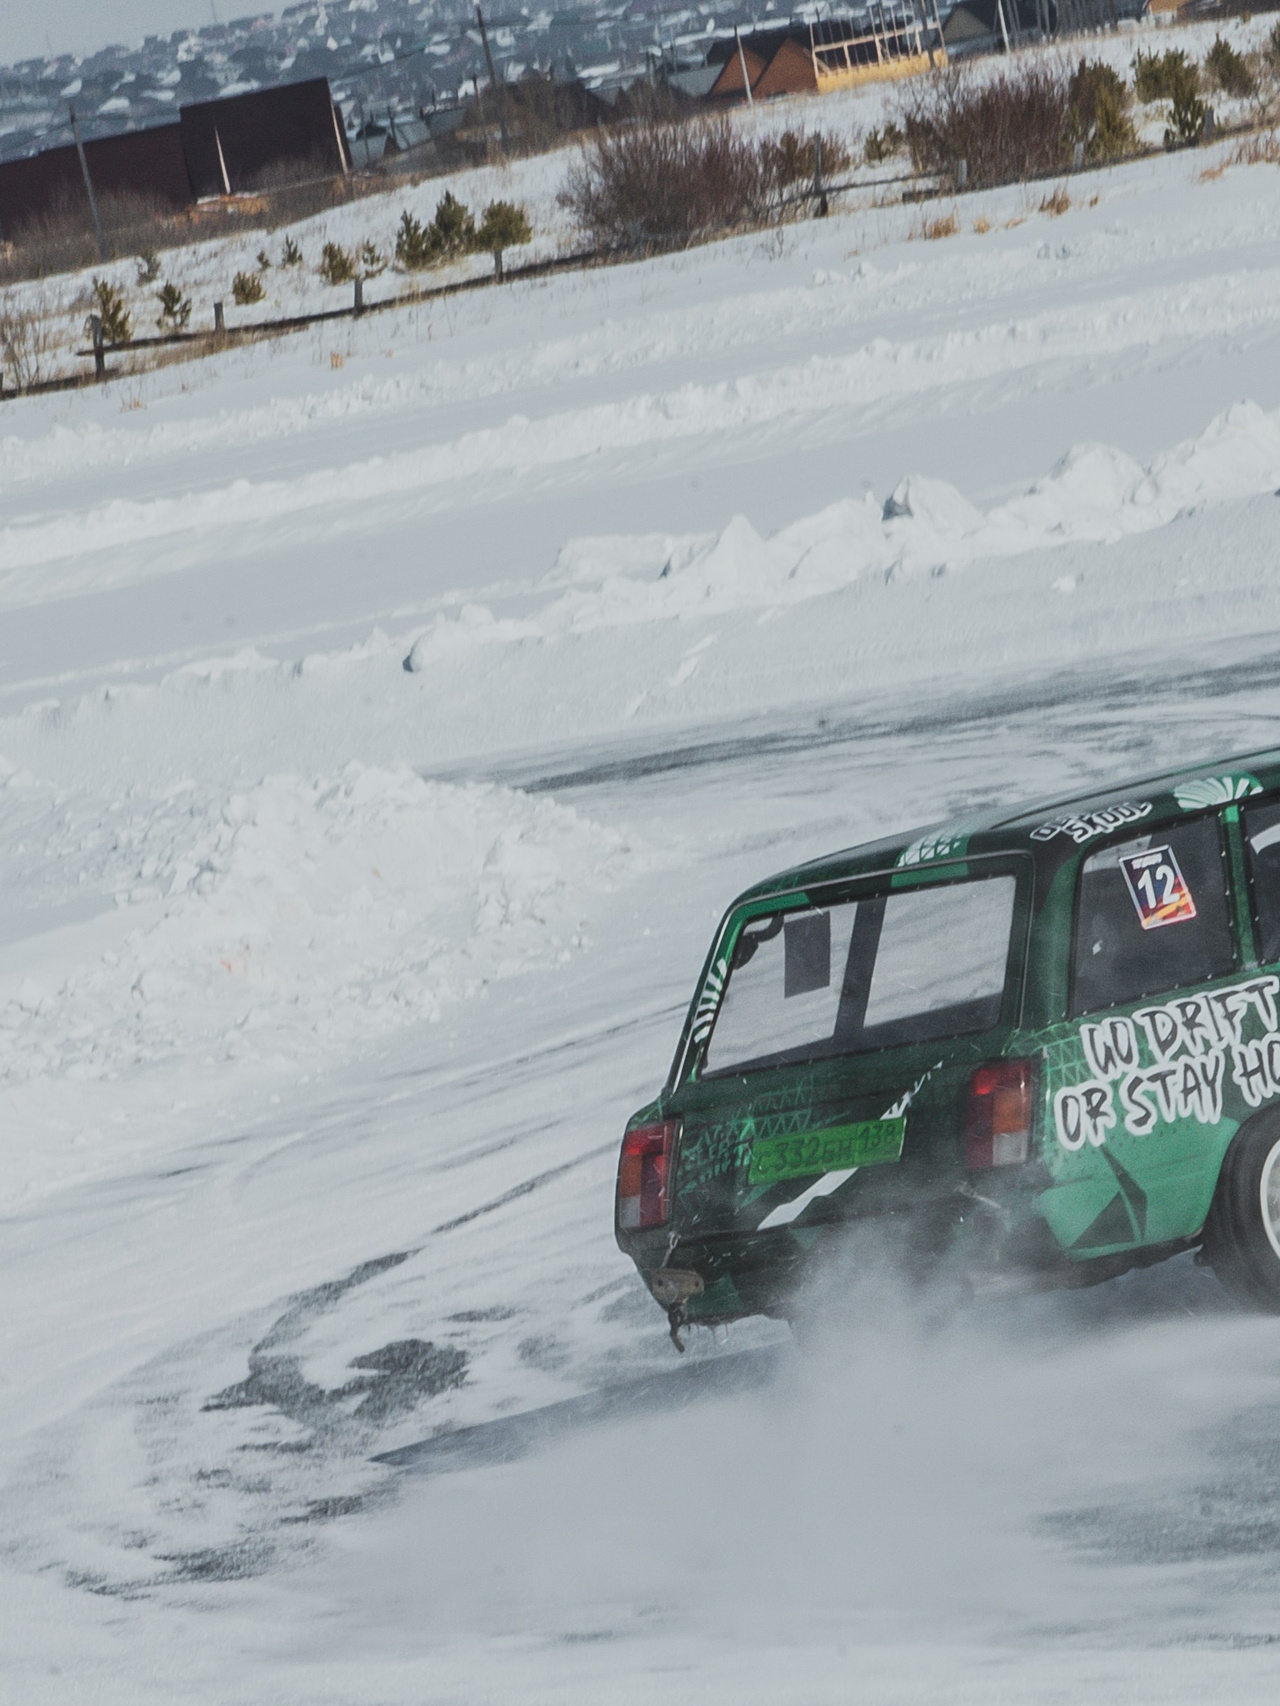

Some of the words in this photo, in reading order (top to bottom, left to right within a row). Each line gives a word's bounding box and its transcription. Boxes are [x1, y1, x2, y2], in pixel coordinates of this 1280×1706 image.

[1138, 864, 1181, 910] 12
[1133, 976, 1280, 1061] DRIFT
[1055, 1081, 1116, 1149] OR
[1120, 1049, 1225, 1135] STAY
